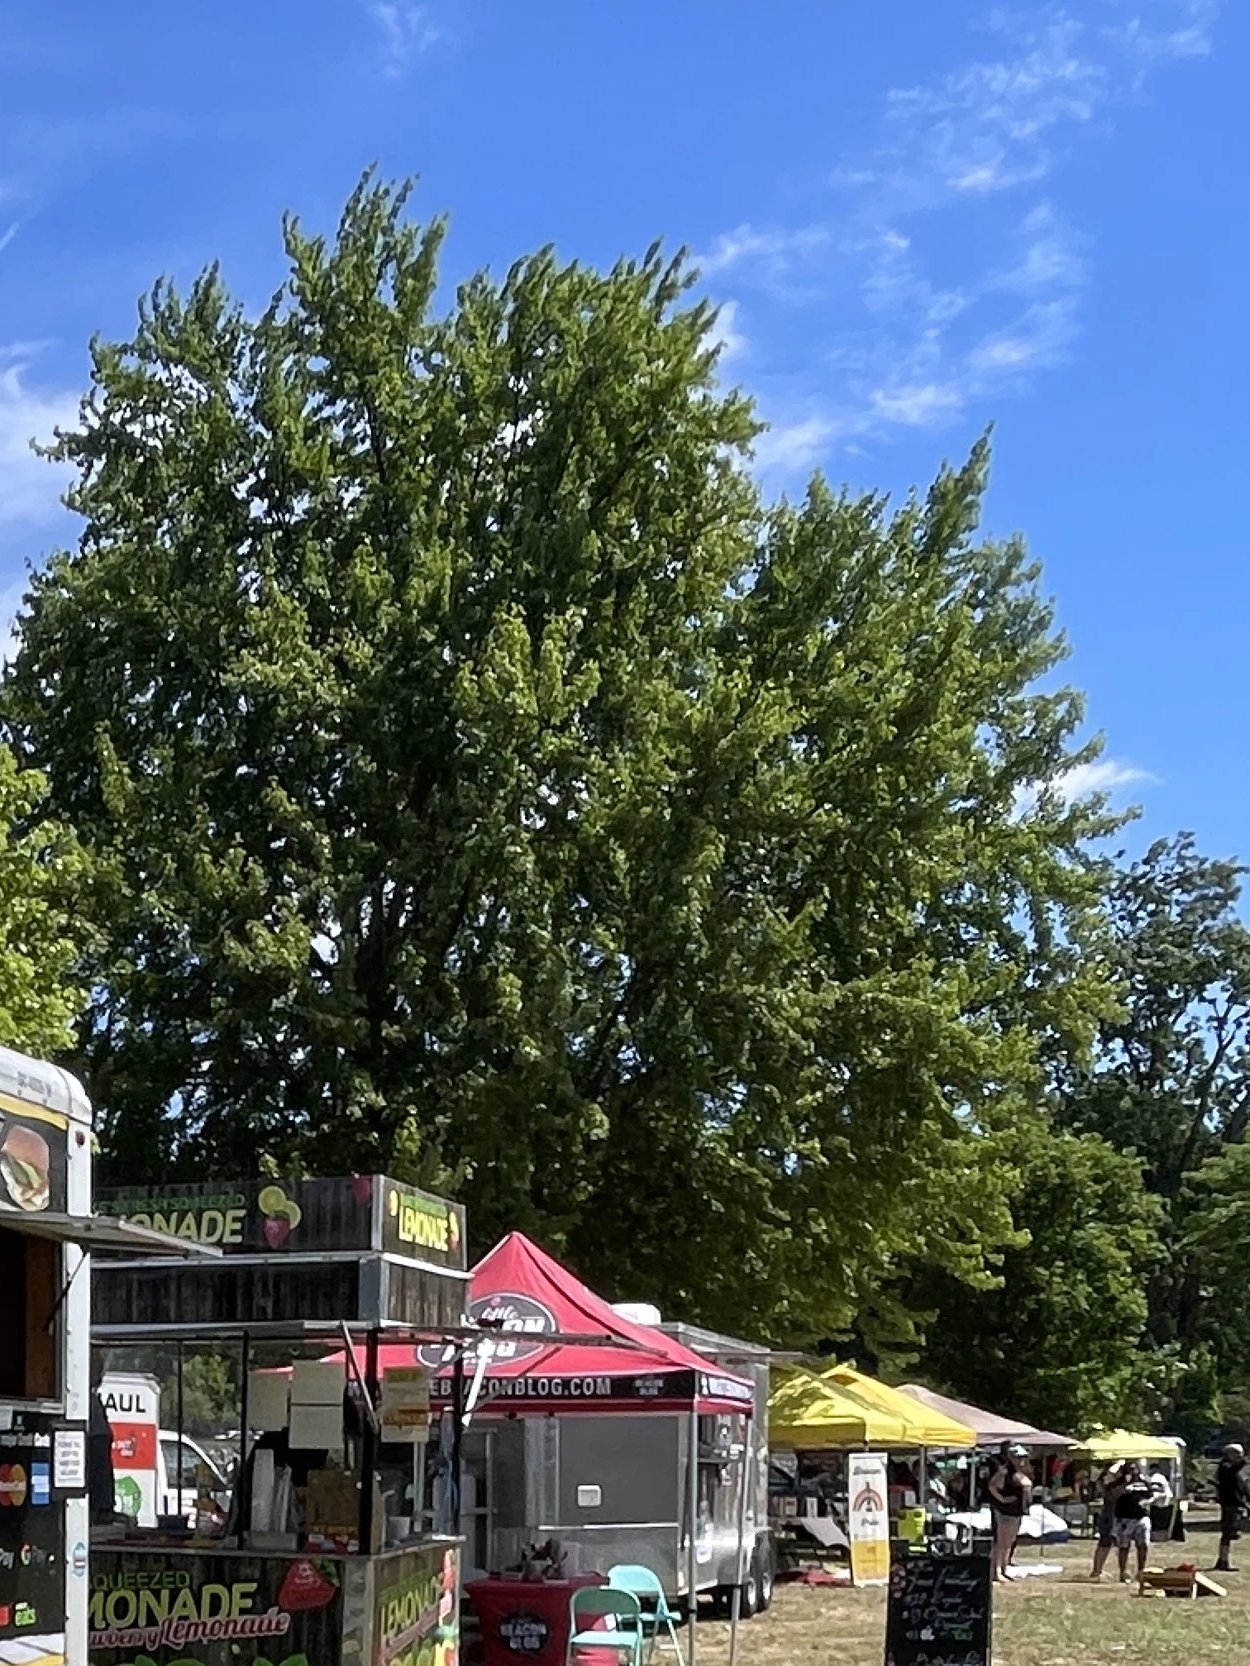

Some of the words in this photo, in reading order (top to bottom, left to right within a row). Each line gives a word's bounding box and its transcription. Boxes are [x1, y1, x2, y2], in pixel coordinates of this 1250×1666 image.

[90, 1569, 190, 1591] QUEEZED
[89, 1582, 258, 1630] MONADE
[160, 1606, 290, 1650] Lemonade
